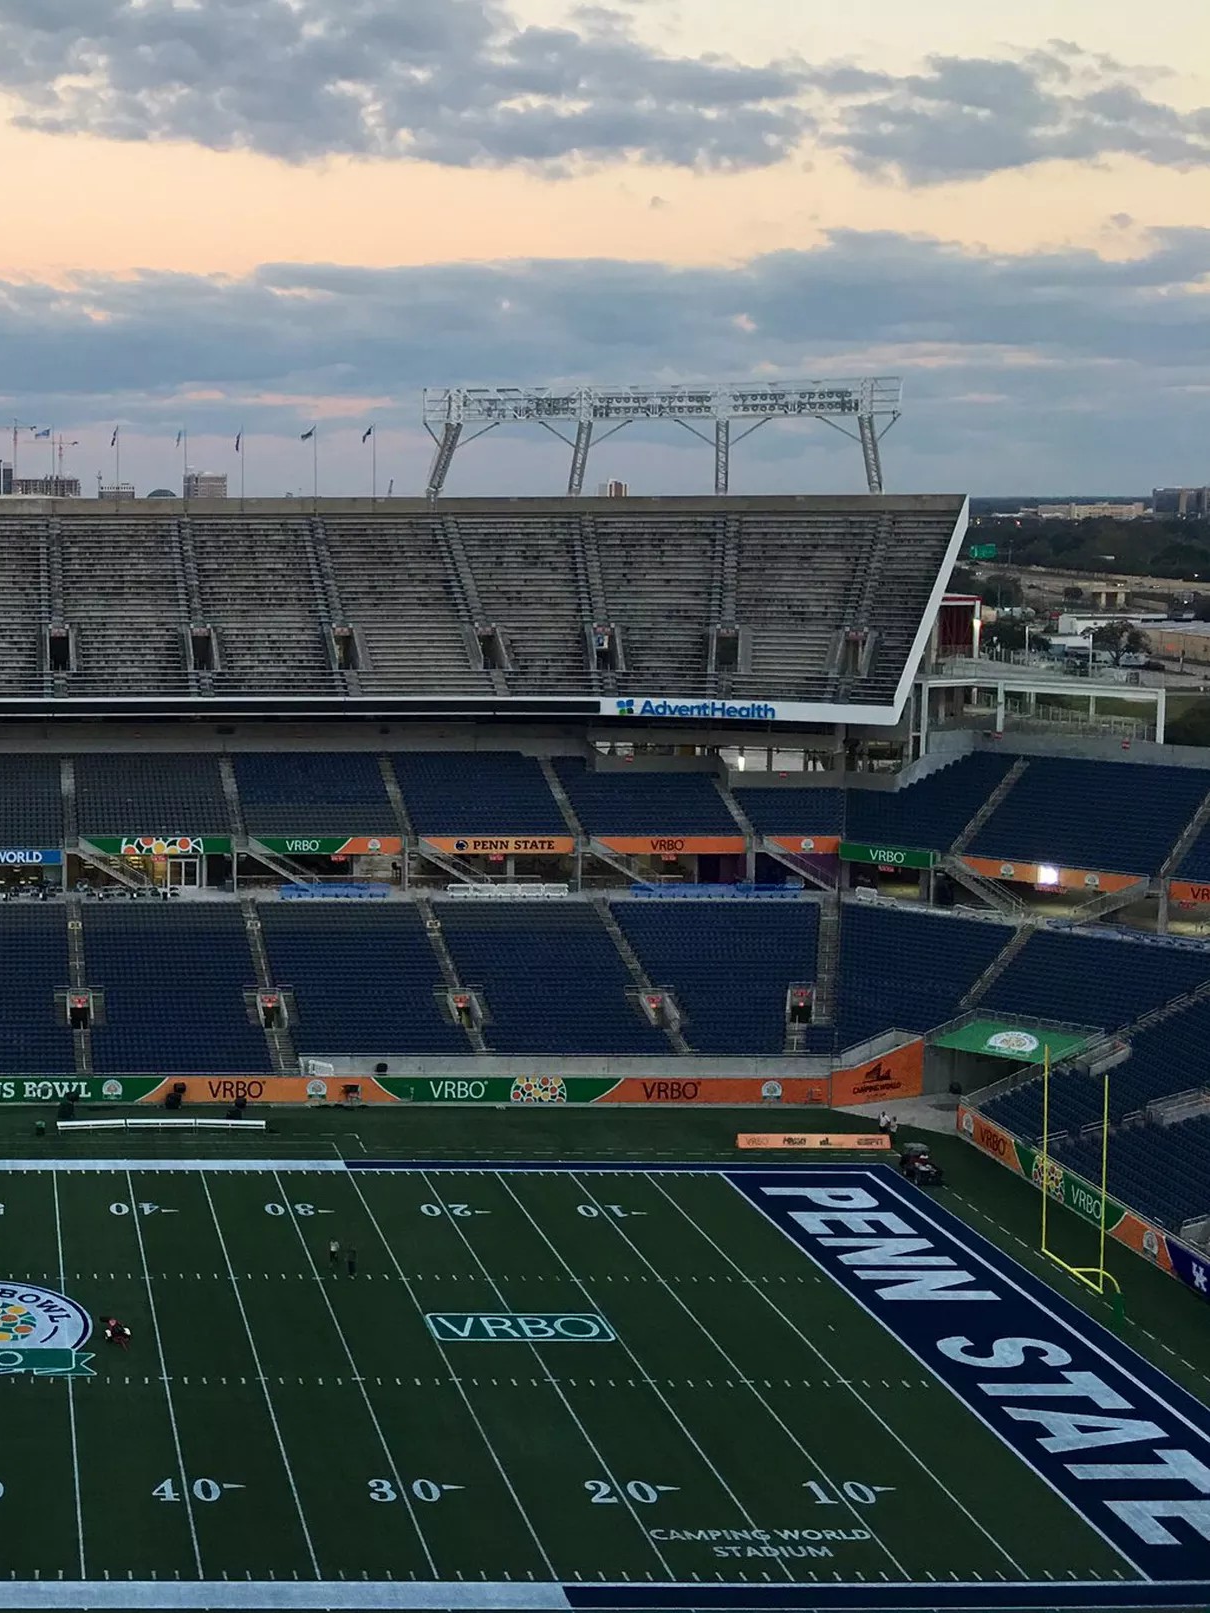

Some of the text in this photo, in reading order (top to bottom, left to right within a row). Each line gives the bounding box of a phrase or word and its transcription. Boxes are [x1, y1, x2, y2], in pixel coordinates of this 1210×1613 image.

[640, 700, 776, 719] AdventHealth
[286, 840, 319, 852] VRBO
[473, 840, 555, 850] PENN STATE
[651, 840, 684, 851] VRBO
[870, 849, 904, 863] VRBO
[23, 1080, 92, 1099] BOWL
[208, 1081, 263, 1098] VRBO
[430, 1081, 486, 1099] VRBO
[643, 1082, 698, 1100] VRBO
[979, 1127, 1006, 1156] VRBO
[1071, 1184, 1102, 1219] VRBO
[760, 1186, 1002, 1301] PENN
[436, 1316, 600, 1338] VRBO
[152, 1478, 222, 1502] 40
[368, 1478, 442, 1502] 30
[583, 1479, 659, 1504] 20
[801, 1480, 877, 1505] 10
[649, 1528, 872, 1541] CAMPING WORLD
[712, 1546, 834, 1558] STADIUM
